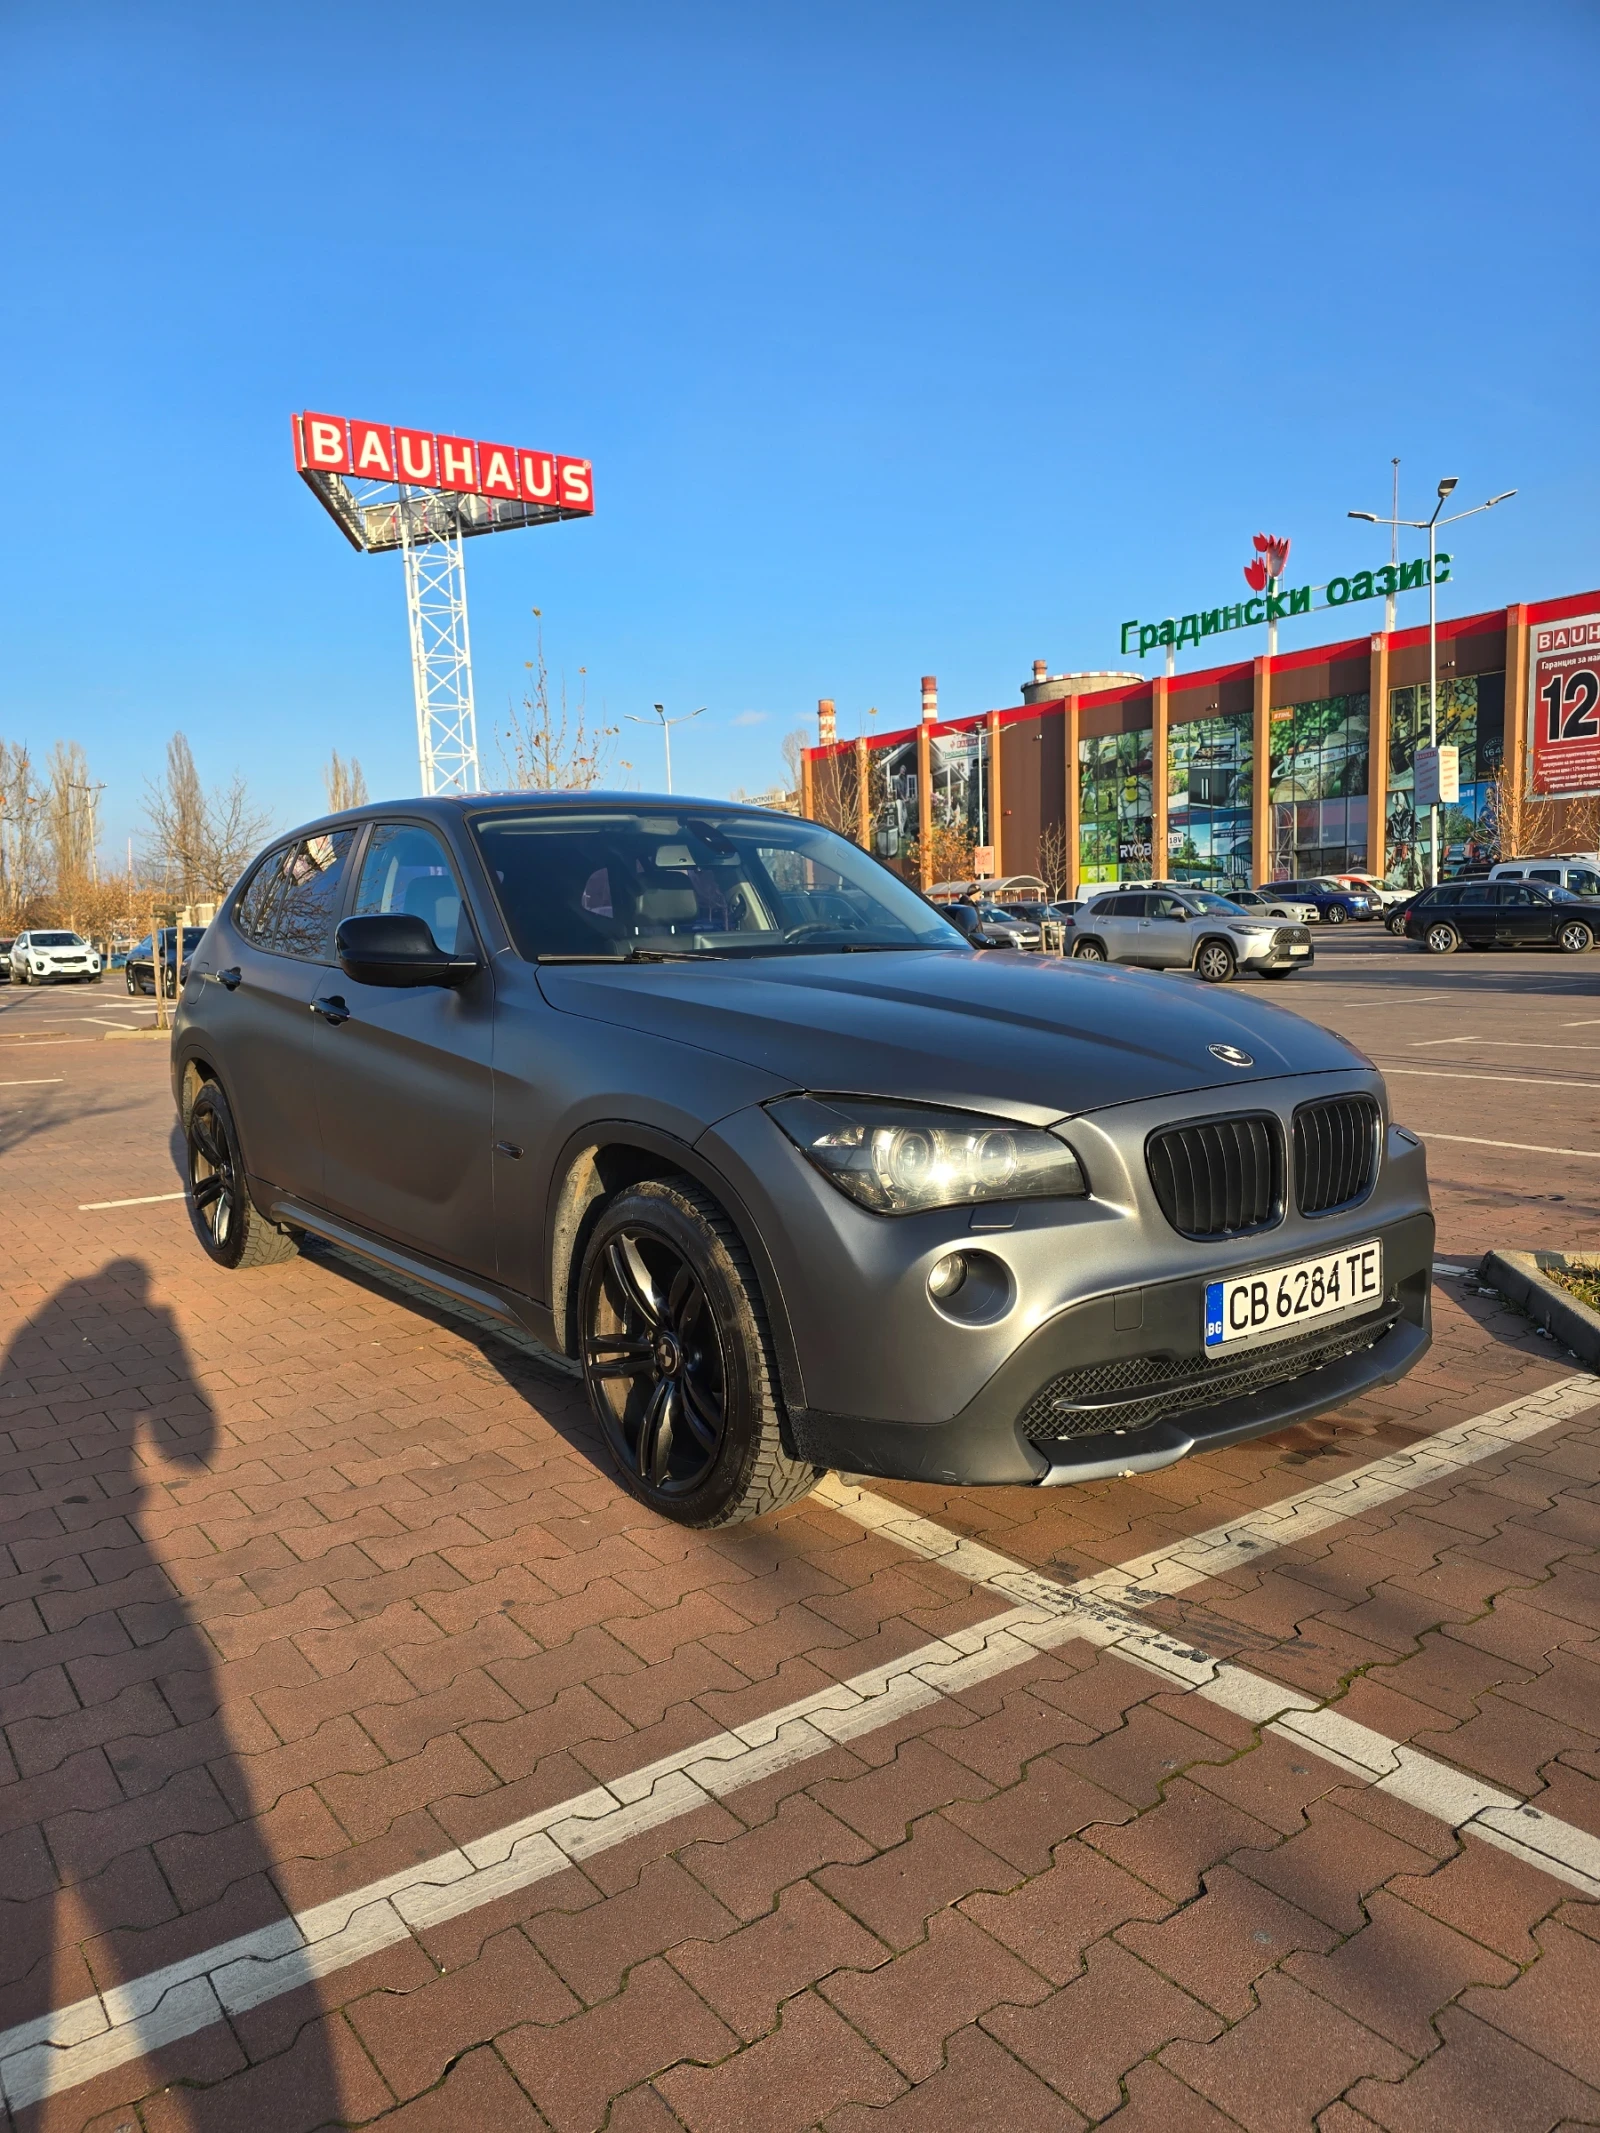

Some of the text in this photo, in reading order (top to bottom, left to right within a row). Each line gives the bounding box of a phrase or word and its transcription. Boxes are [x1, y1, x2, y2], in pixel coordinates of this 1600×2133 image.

[311, 420, 590, 503] BAUHAUS
[1121, 553, 1453, 658] Градински оазис
[1541, 658, 1577, 671] Гаранция
[1577, 656, 1587, 664] за
[1541, 669, 1600, 743] 12
[1168, 836, 1183, 845] 18V
[1229, 1249, 1376, 1330] CB 6284 TE
[1207, 1321, 1222, 1336] BG
